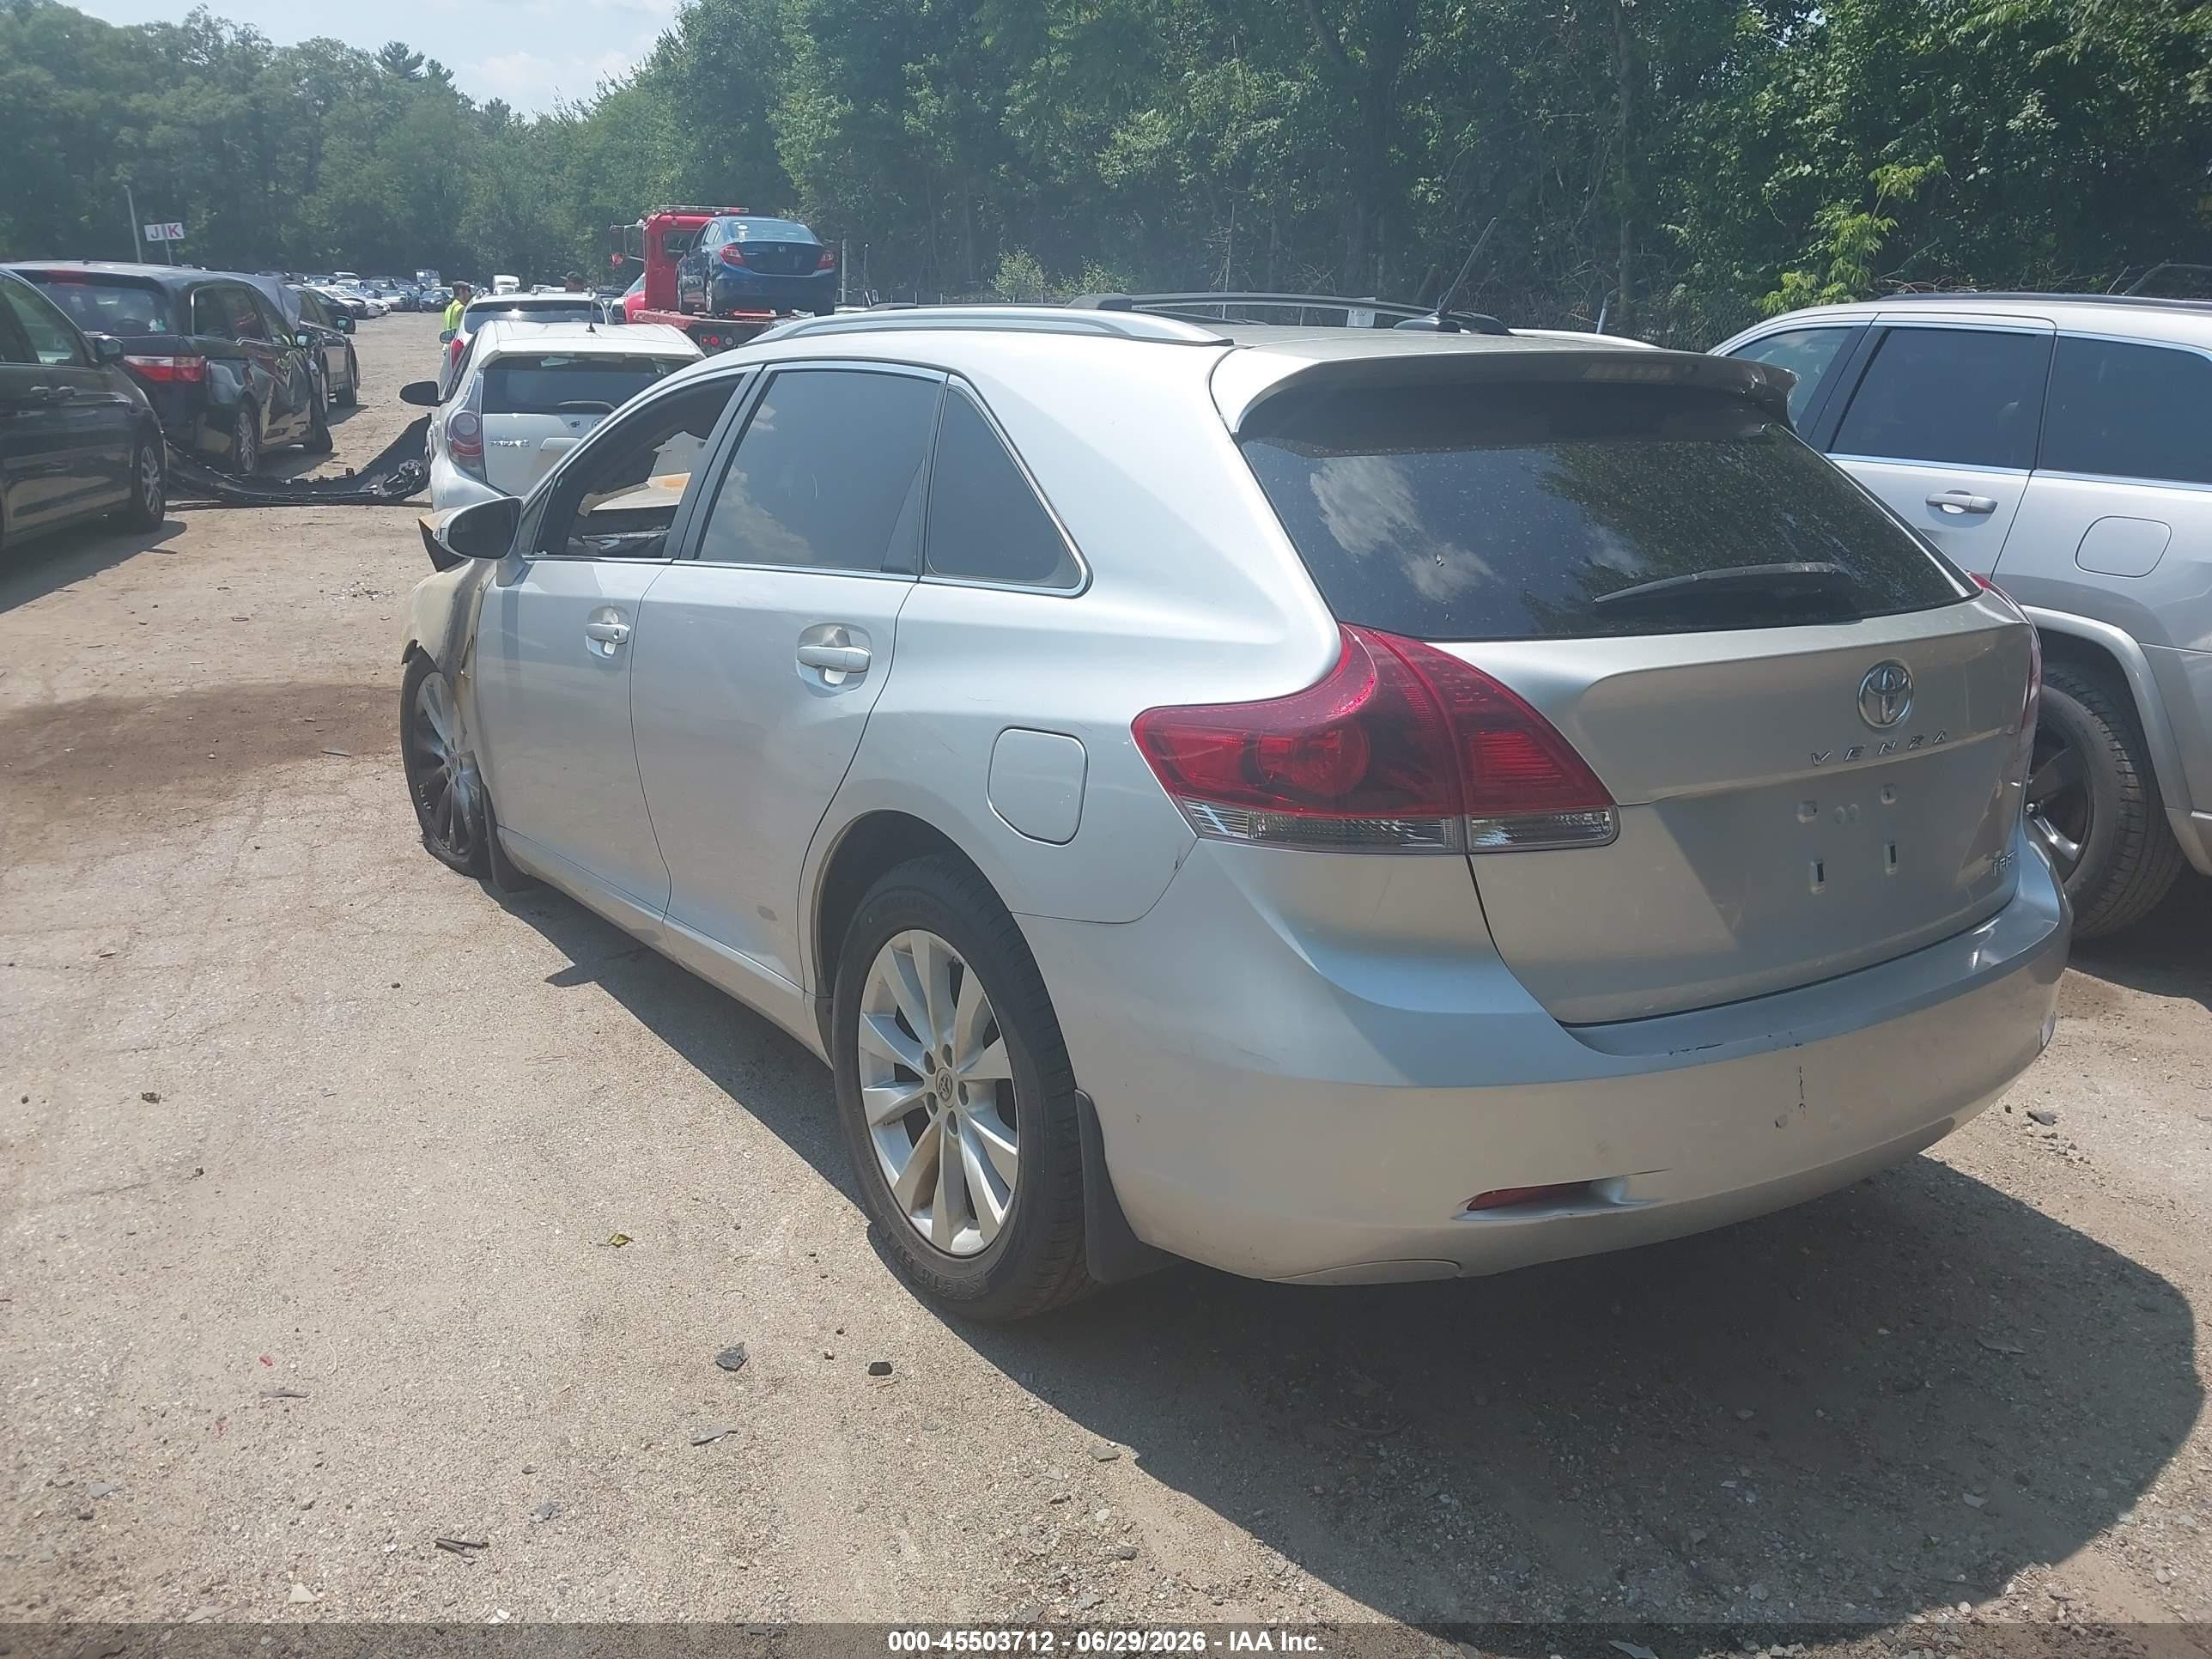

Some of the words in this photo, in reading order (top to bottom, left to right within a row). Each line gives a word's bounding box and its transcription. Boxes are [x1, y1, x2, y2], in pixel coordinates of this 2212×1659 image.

[151, 226, 160, 239] J
[167, 224, 182, 238] K
[1810, 730, 1947, 766] VENZA
